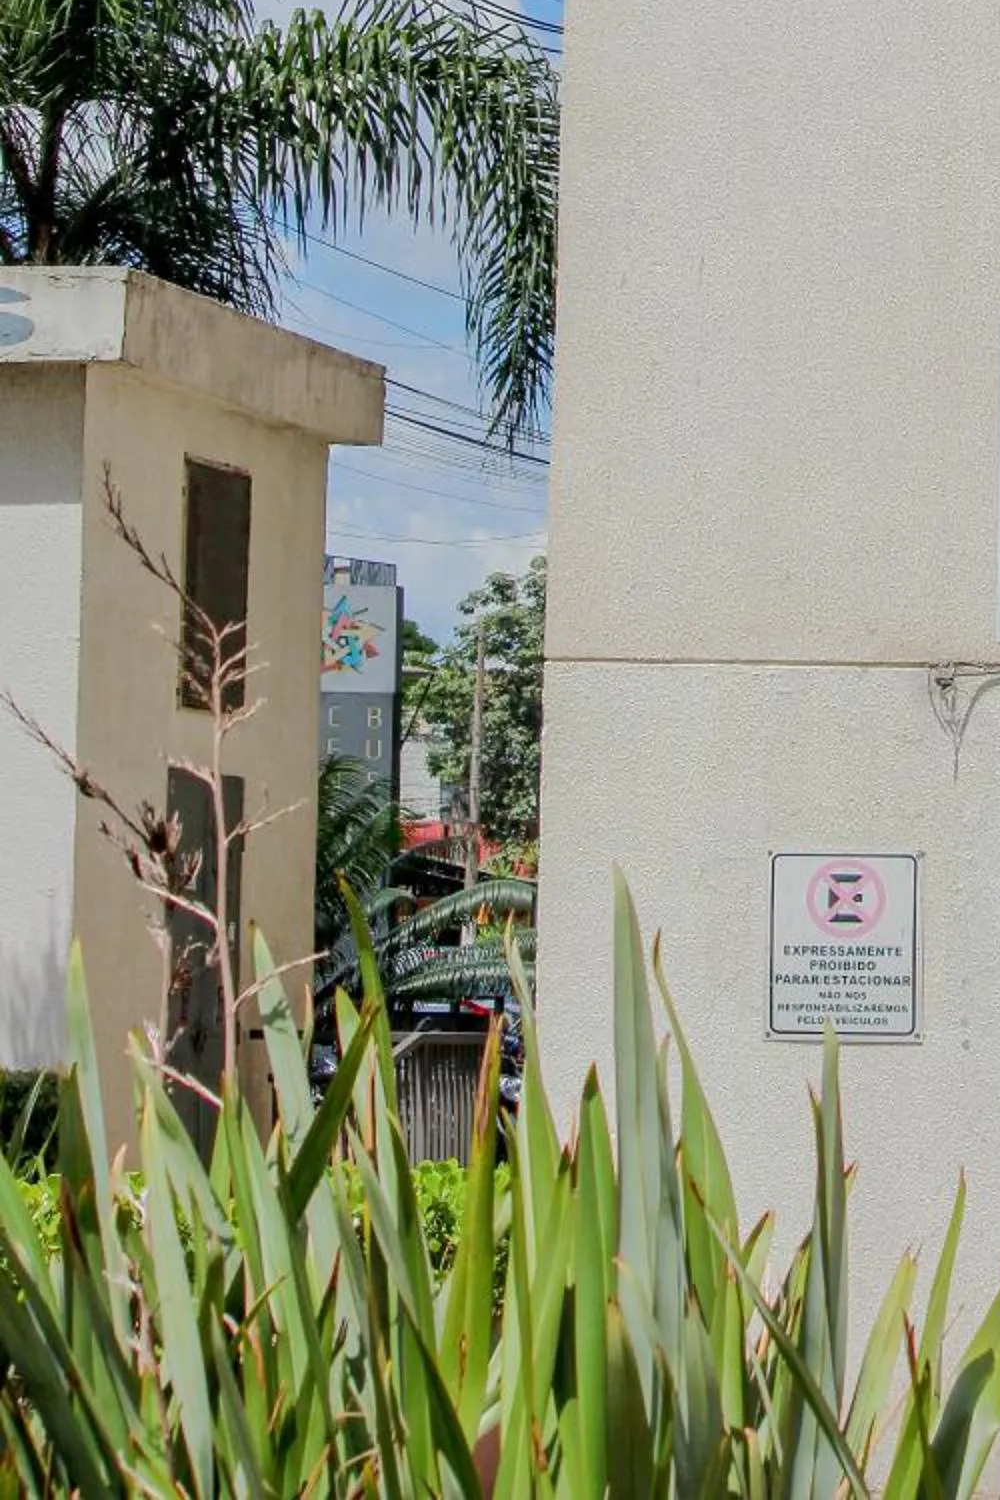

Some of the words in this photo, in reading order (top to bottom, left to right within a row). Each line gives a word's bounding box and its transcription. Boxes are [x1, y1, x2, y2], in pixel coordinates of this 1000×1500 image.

[783, 945, 903, 957] EXPRESSAMENTE
[809, 960, 877, 971] PROIBIDO
[845, 992, 867, 1000] NOS
